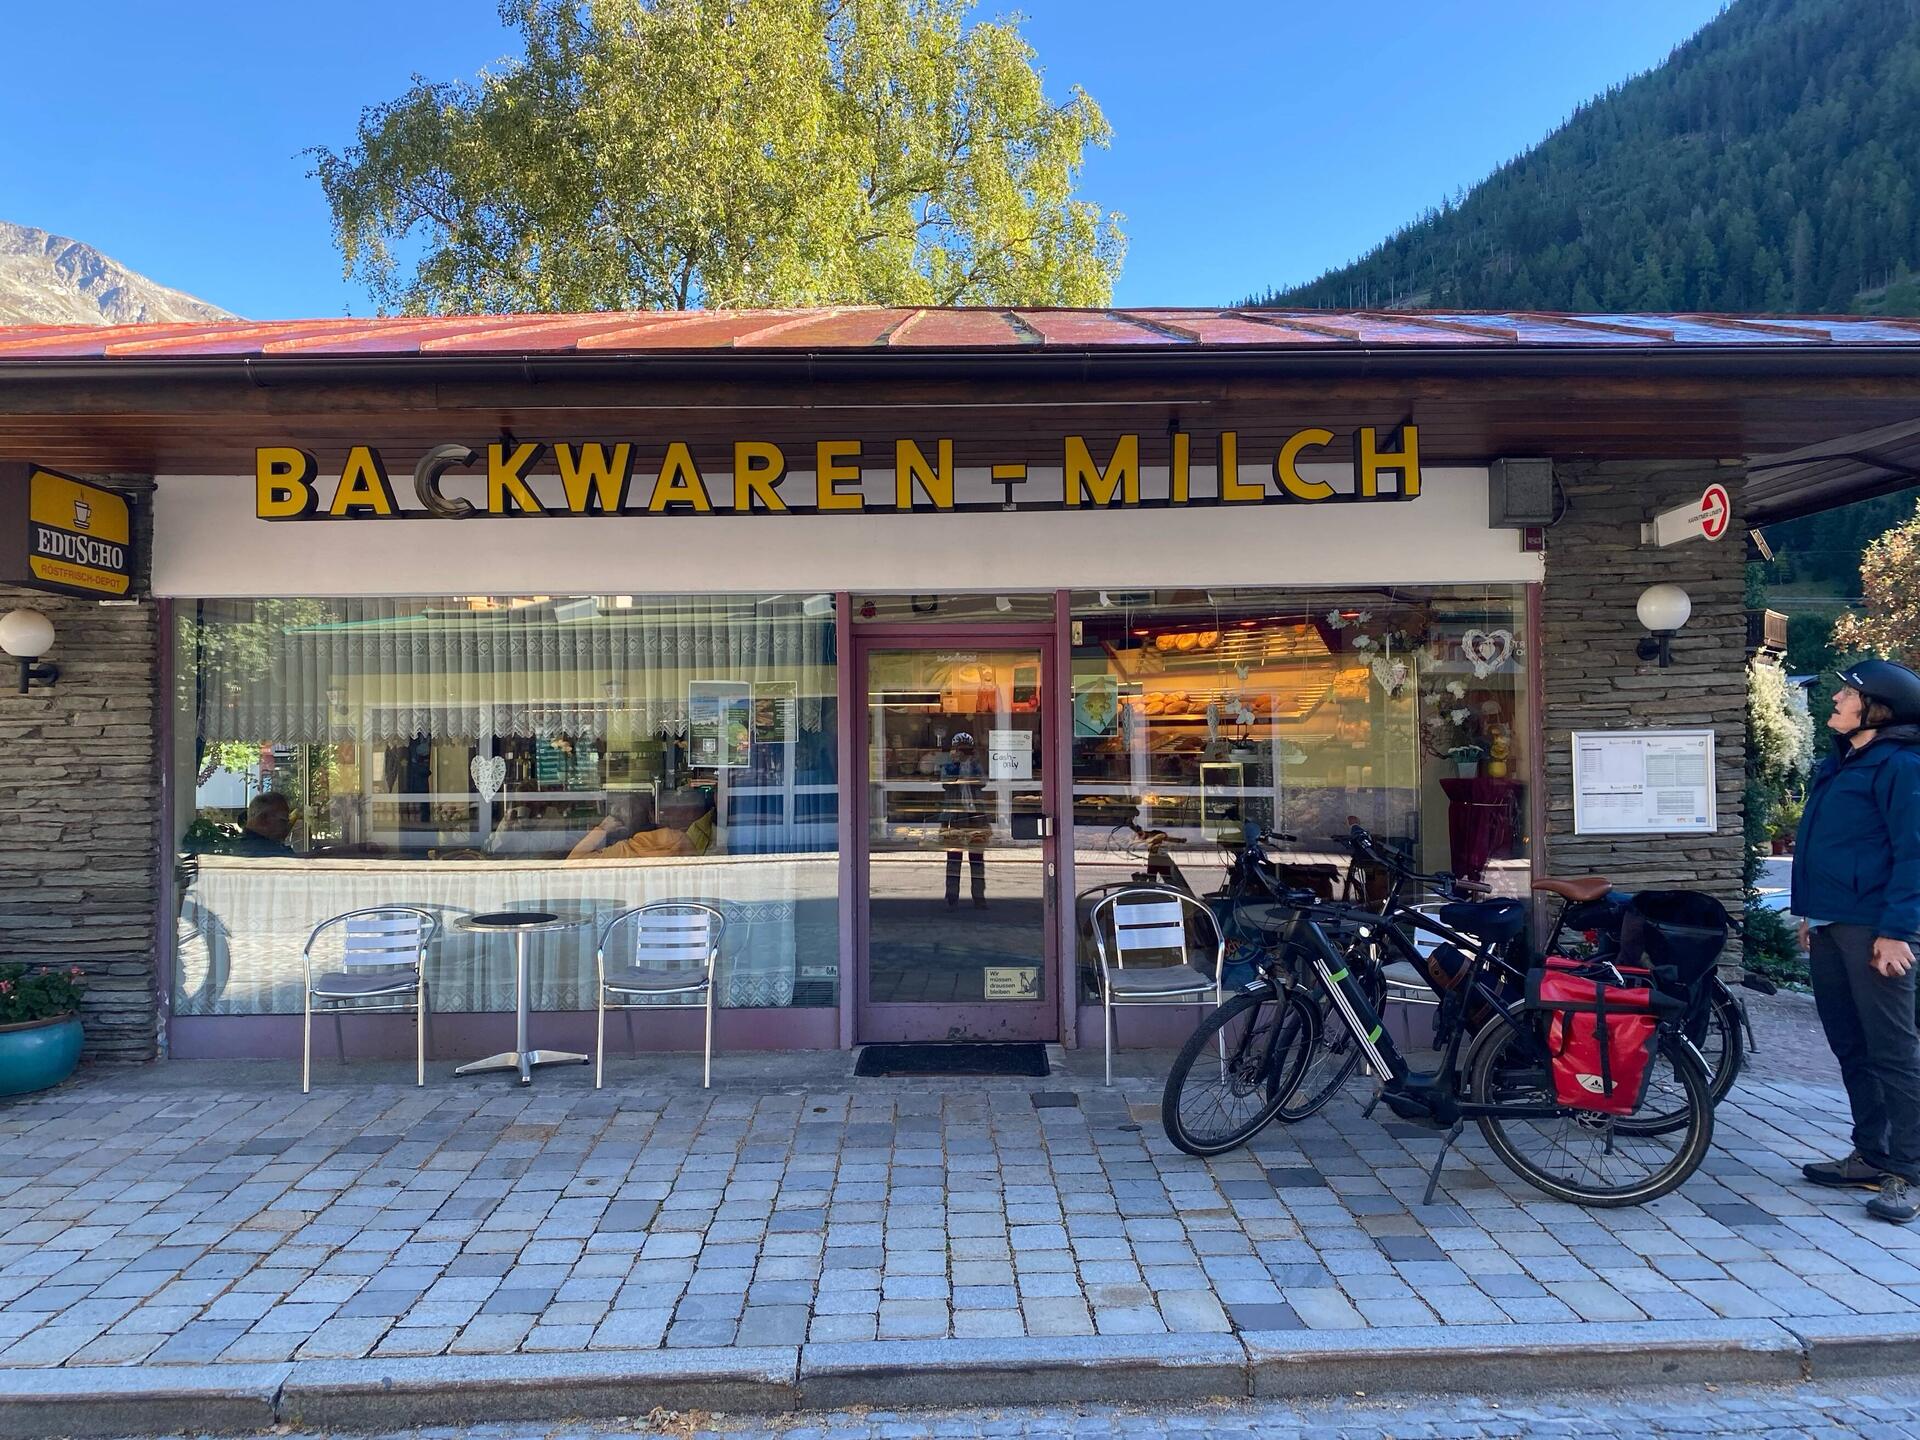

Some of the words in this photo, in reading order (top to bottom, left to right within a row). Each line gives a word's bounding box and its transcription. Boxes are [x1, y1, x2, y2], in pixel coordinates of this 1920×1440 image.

[255, 438, 956, 522] BACKWAREN
[1062, 425, 1421, 508] MILCH
[37, 527, 124, 570] EDUSCHO
[41, 563, 121, 588] RÖSTFRISCH-DEPOT
[1003, 760, 1018, 768] only
